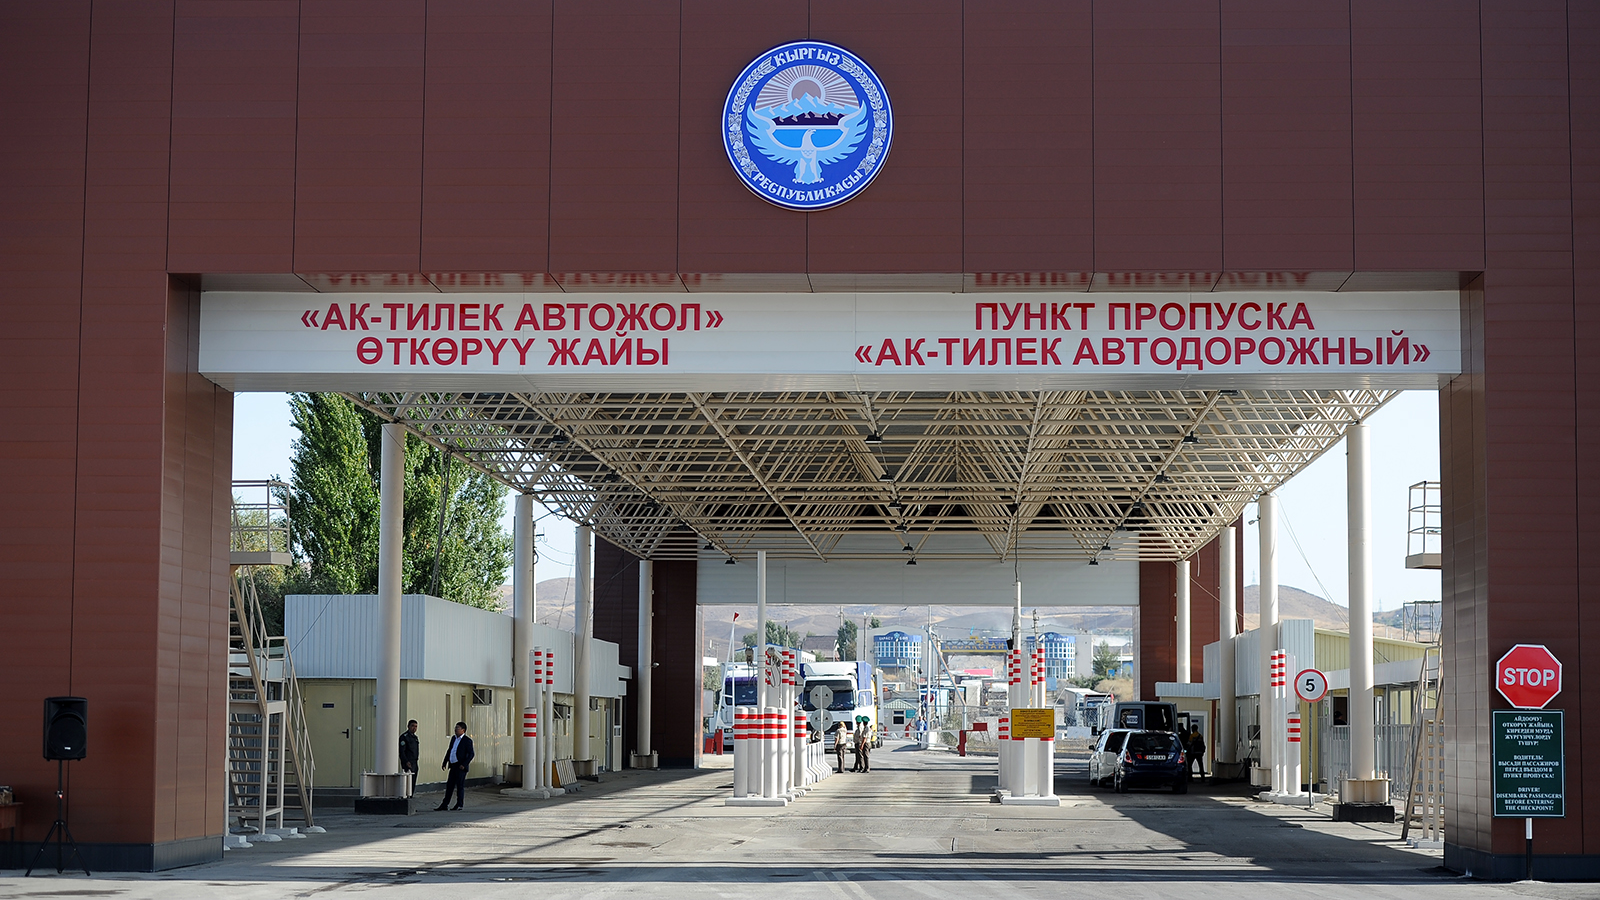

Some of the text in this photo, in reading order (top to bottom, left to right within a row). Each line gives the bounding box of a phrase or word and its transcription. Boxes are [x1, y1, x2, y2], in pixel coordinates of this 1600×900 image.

[773, 48, 840, 67] КЫРГЫЗ
[752, 169, 864, 202] РЕСПУБЛИКАСЫ
[301, 302, 724, 335] «АК-ТИЛЕК АВТОЖОЛ»
[975, 302, 1315, 331] ПУНКТ ПРОПУСКА
[356, 333, 669, 366] ӨТКӨРҮҮ ЖАЙЫ
[854, 330, 1431, 371] «АК-ТИЛЕК АВТОДОРОЖНЫЙ»
[1305, 678, 1315, 692] 5
[1503, 668, 1555, 686] STOP
